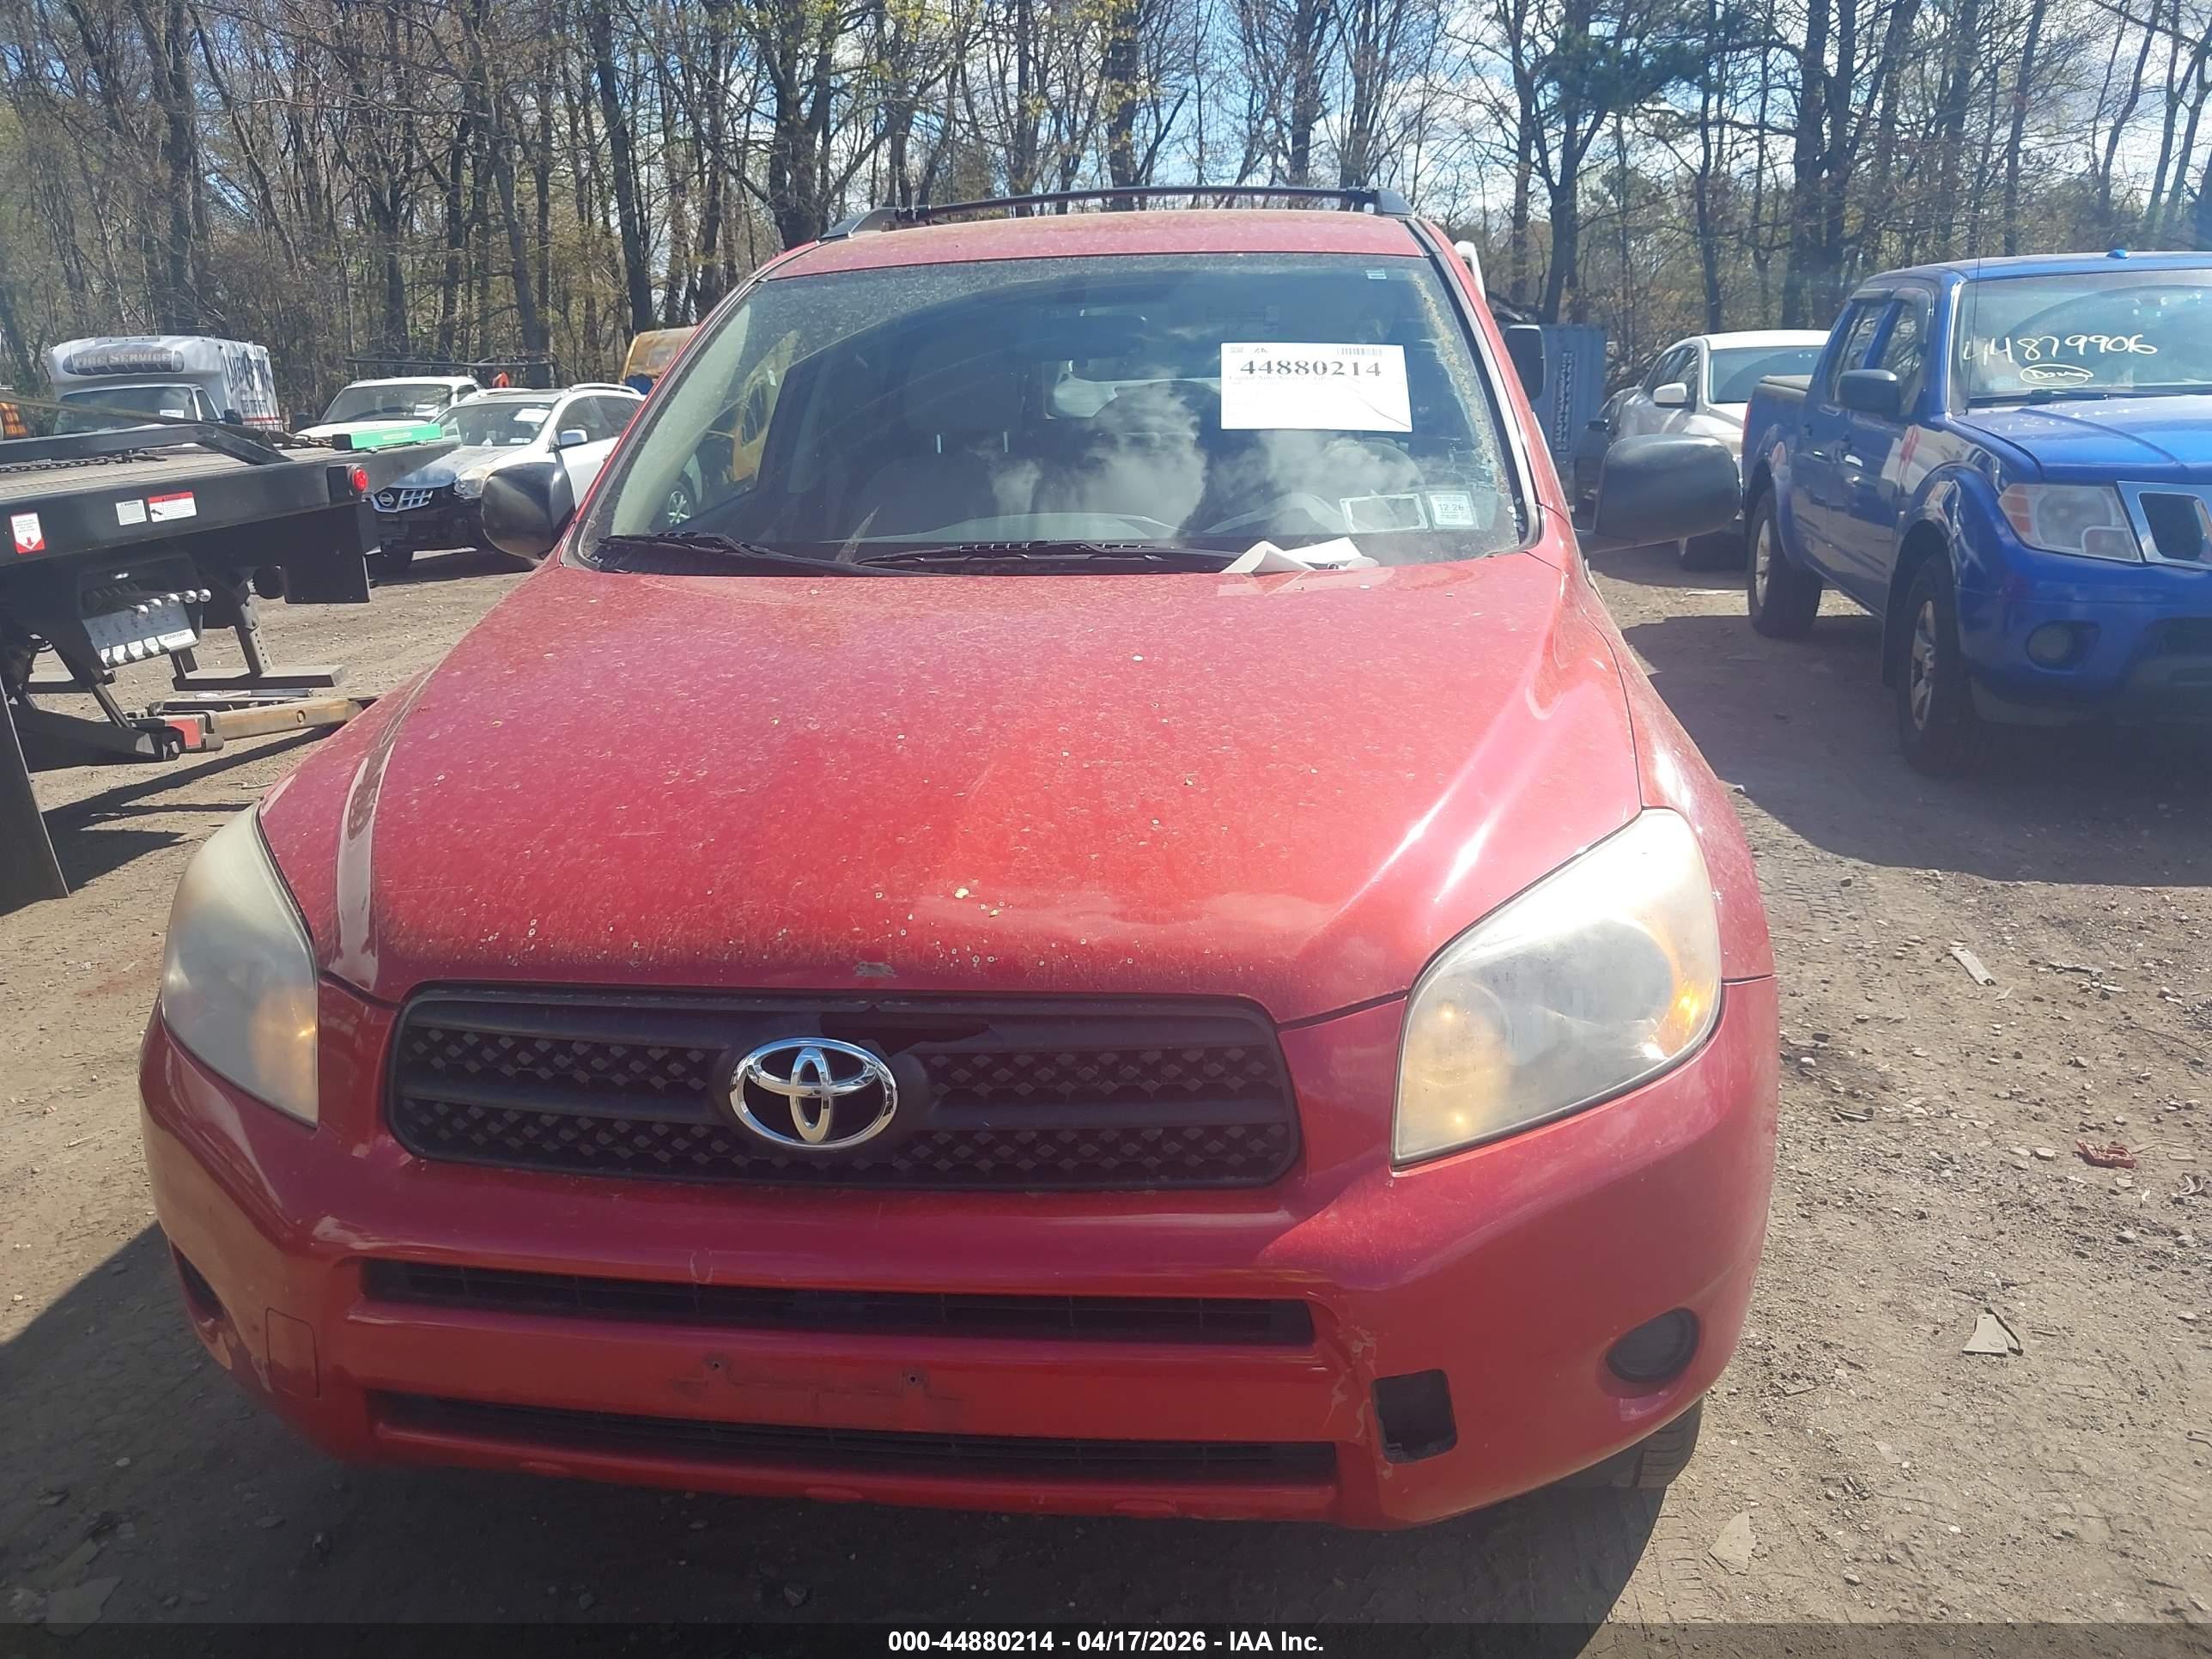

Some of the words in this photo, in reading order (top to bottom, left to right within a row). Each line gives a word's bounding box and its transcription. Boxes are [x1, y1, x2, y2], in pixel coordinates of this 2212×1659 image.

[108, 349, 173, 365] SERVICE
[1963, 334, 2158, 366] 44879906
[1240, 359, 1382, 377] 44880214
